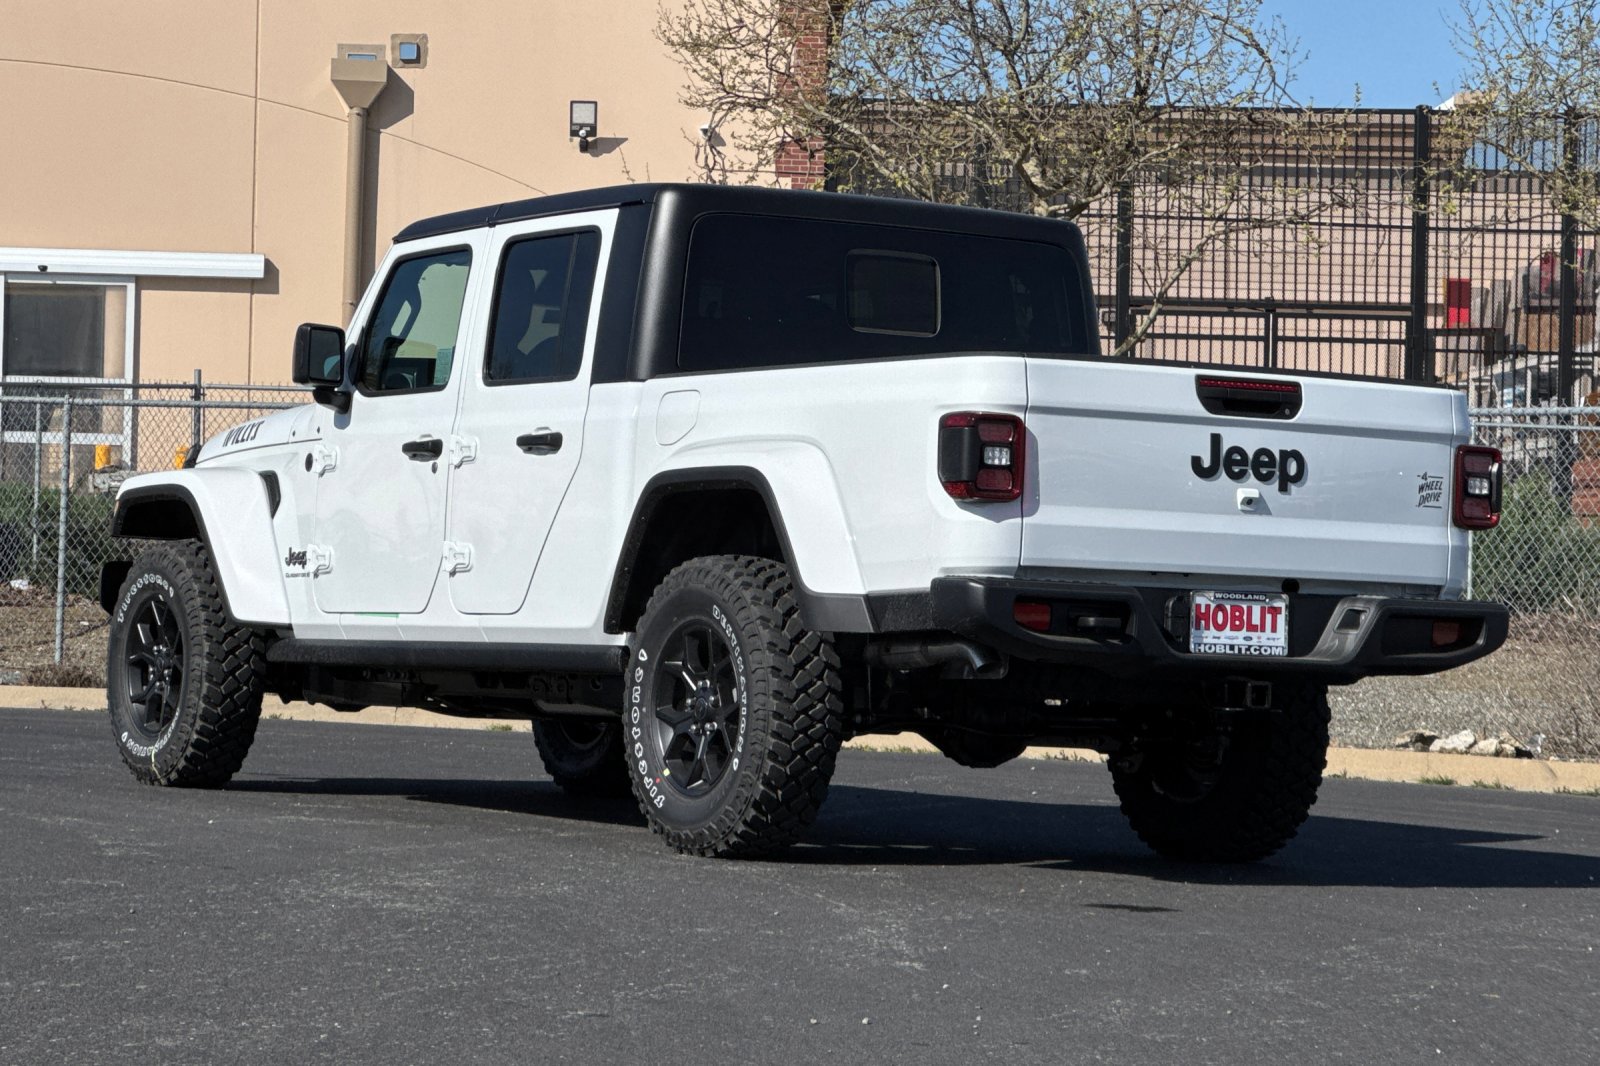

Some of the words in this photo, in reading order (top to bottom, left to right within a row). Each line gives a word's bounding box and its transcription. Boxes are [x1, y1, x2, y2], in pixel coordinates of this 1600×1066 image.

[222, 420, 265, 448] WILLYS
[1191, 432, 1306, 493] Jeep
[1421, 471, 1428, 481] 4
[1418, 480, 1443, 494] WHEEL
[1417, 491, 1442, 508] DRIVE
[285, 546, 308, 569] Jeep
[1215, 592, 1266, 600] WOODLAND
[1194, 603, 1282, 634] HOBLIT
[1195, 643, 1283, 656] HOBLIT.COM
